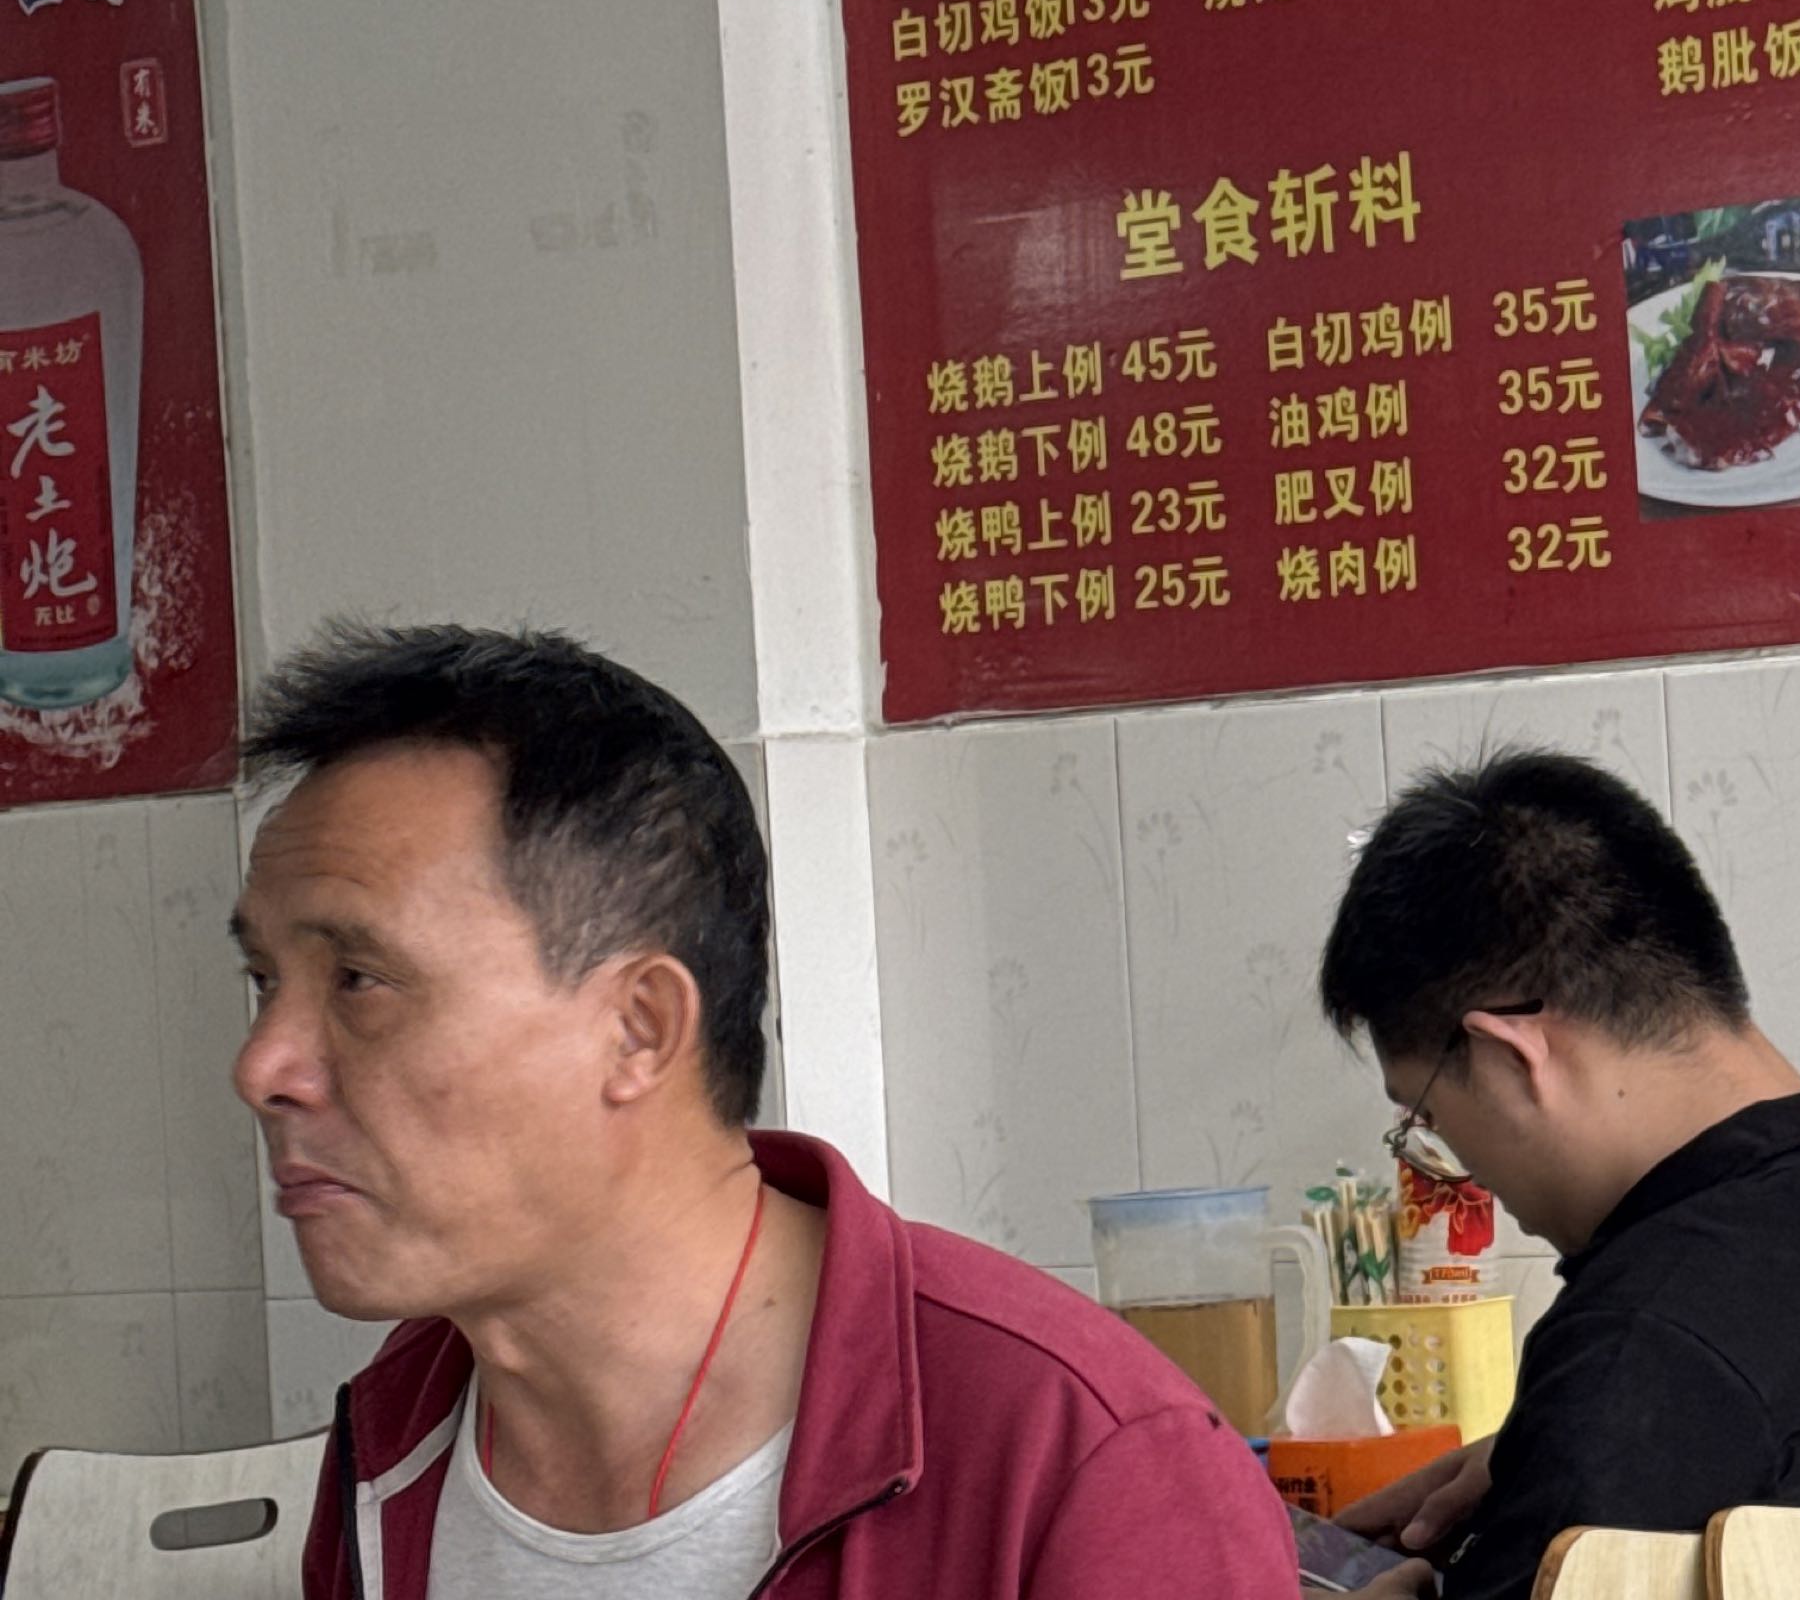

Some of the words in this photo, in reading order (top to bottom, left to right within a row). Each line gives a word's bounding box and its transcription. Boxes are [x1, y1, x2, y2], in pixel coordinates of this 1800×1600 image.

[896, 58, 1071, 137] 罗汉斋饭
[1116, 151, 1421, 280] 堂食斩料
[1267, 296, 1452, 371] 白切鸡例
[1494, 279, 1597, 337] 35元
[926, 343, 1103, 414] 烧鹅上例
[1121, 328, 1217, 383] 45元
[1270, 381, 1408, 448] 油鸡例
[1499, 357, 1602, 415] 35元
[930, 416, 1107, 487] 烧鹅下例
[1126, 404, 1222, 457] 48元
[1275, 459, 1413, 524] 肥叉例
[1503, 436, 1608, 494] 32元
[6, 383, 98, 600] 老土炮
[935, 493, 1112, 561] 烧鸭上例
[1131, 480, 1226, 534] 23元
[939, 567, 1115, 634] 烧鸭下例
[1135, 556, 1230, 609] 25元
[1276, 535, 1417, 602] 烧肉例
[1508, 516, 1612, 572] 32元
